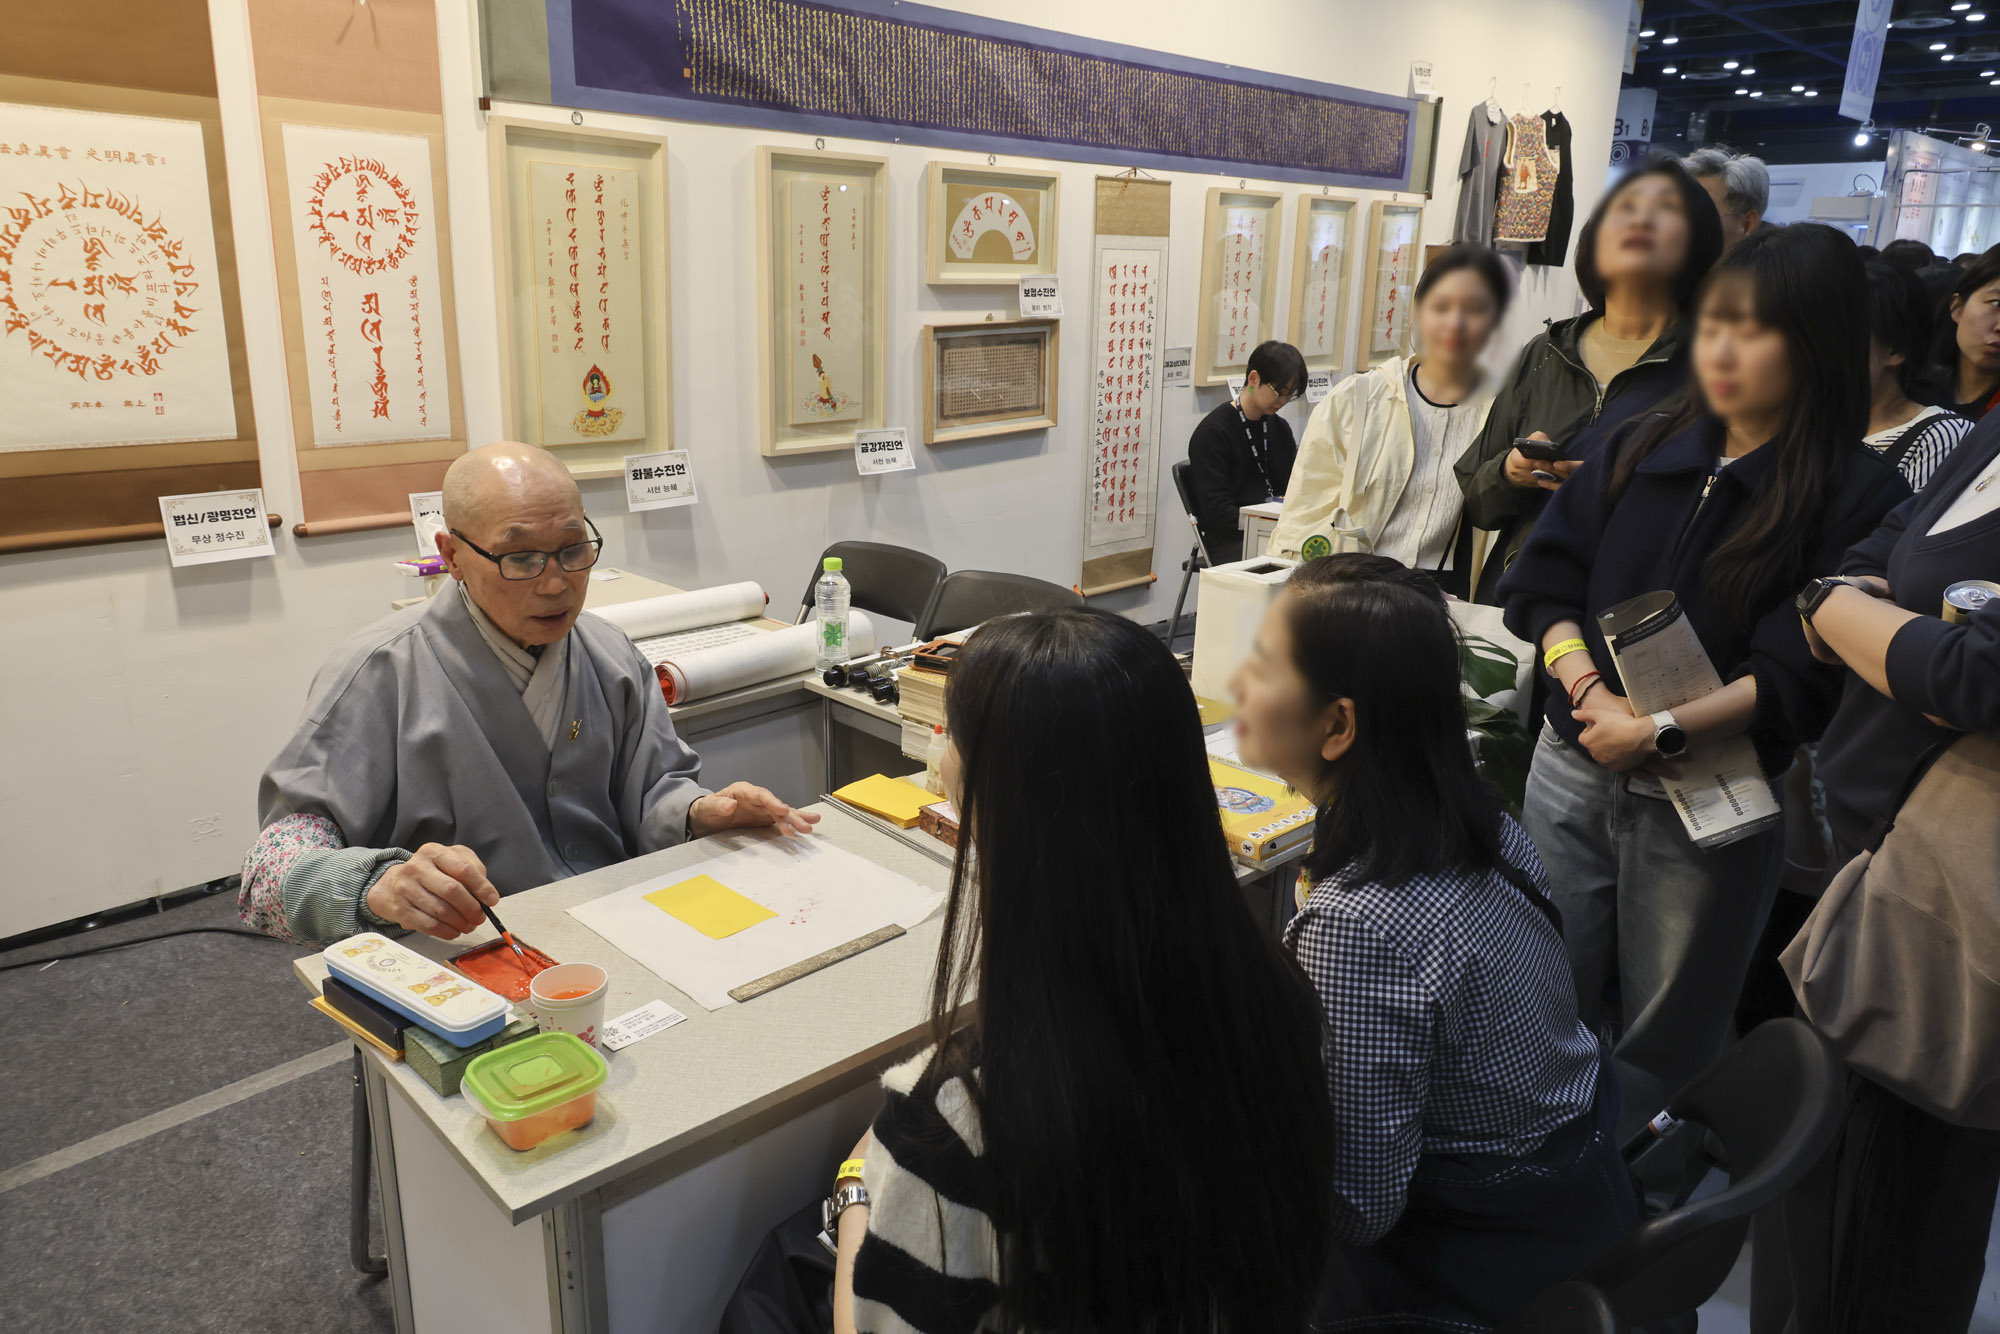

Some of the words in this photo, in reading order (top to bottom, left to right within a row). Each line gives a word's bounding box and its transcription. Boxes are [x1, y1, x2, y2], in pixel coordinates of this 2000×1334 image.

[1614, 118, 1630, 137] B1
[860, 440, 904, 453] 금강저진언
[631, 463, 686, 481] 화불수진언
[647, 486, 661, 494] 서천
[663, 483, 678, 493] 능혜
[192, 534, 212, 545] 무상
[215, 530, 245, 543] 정수진
